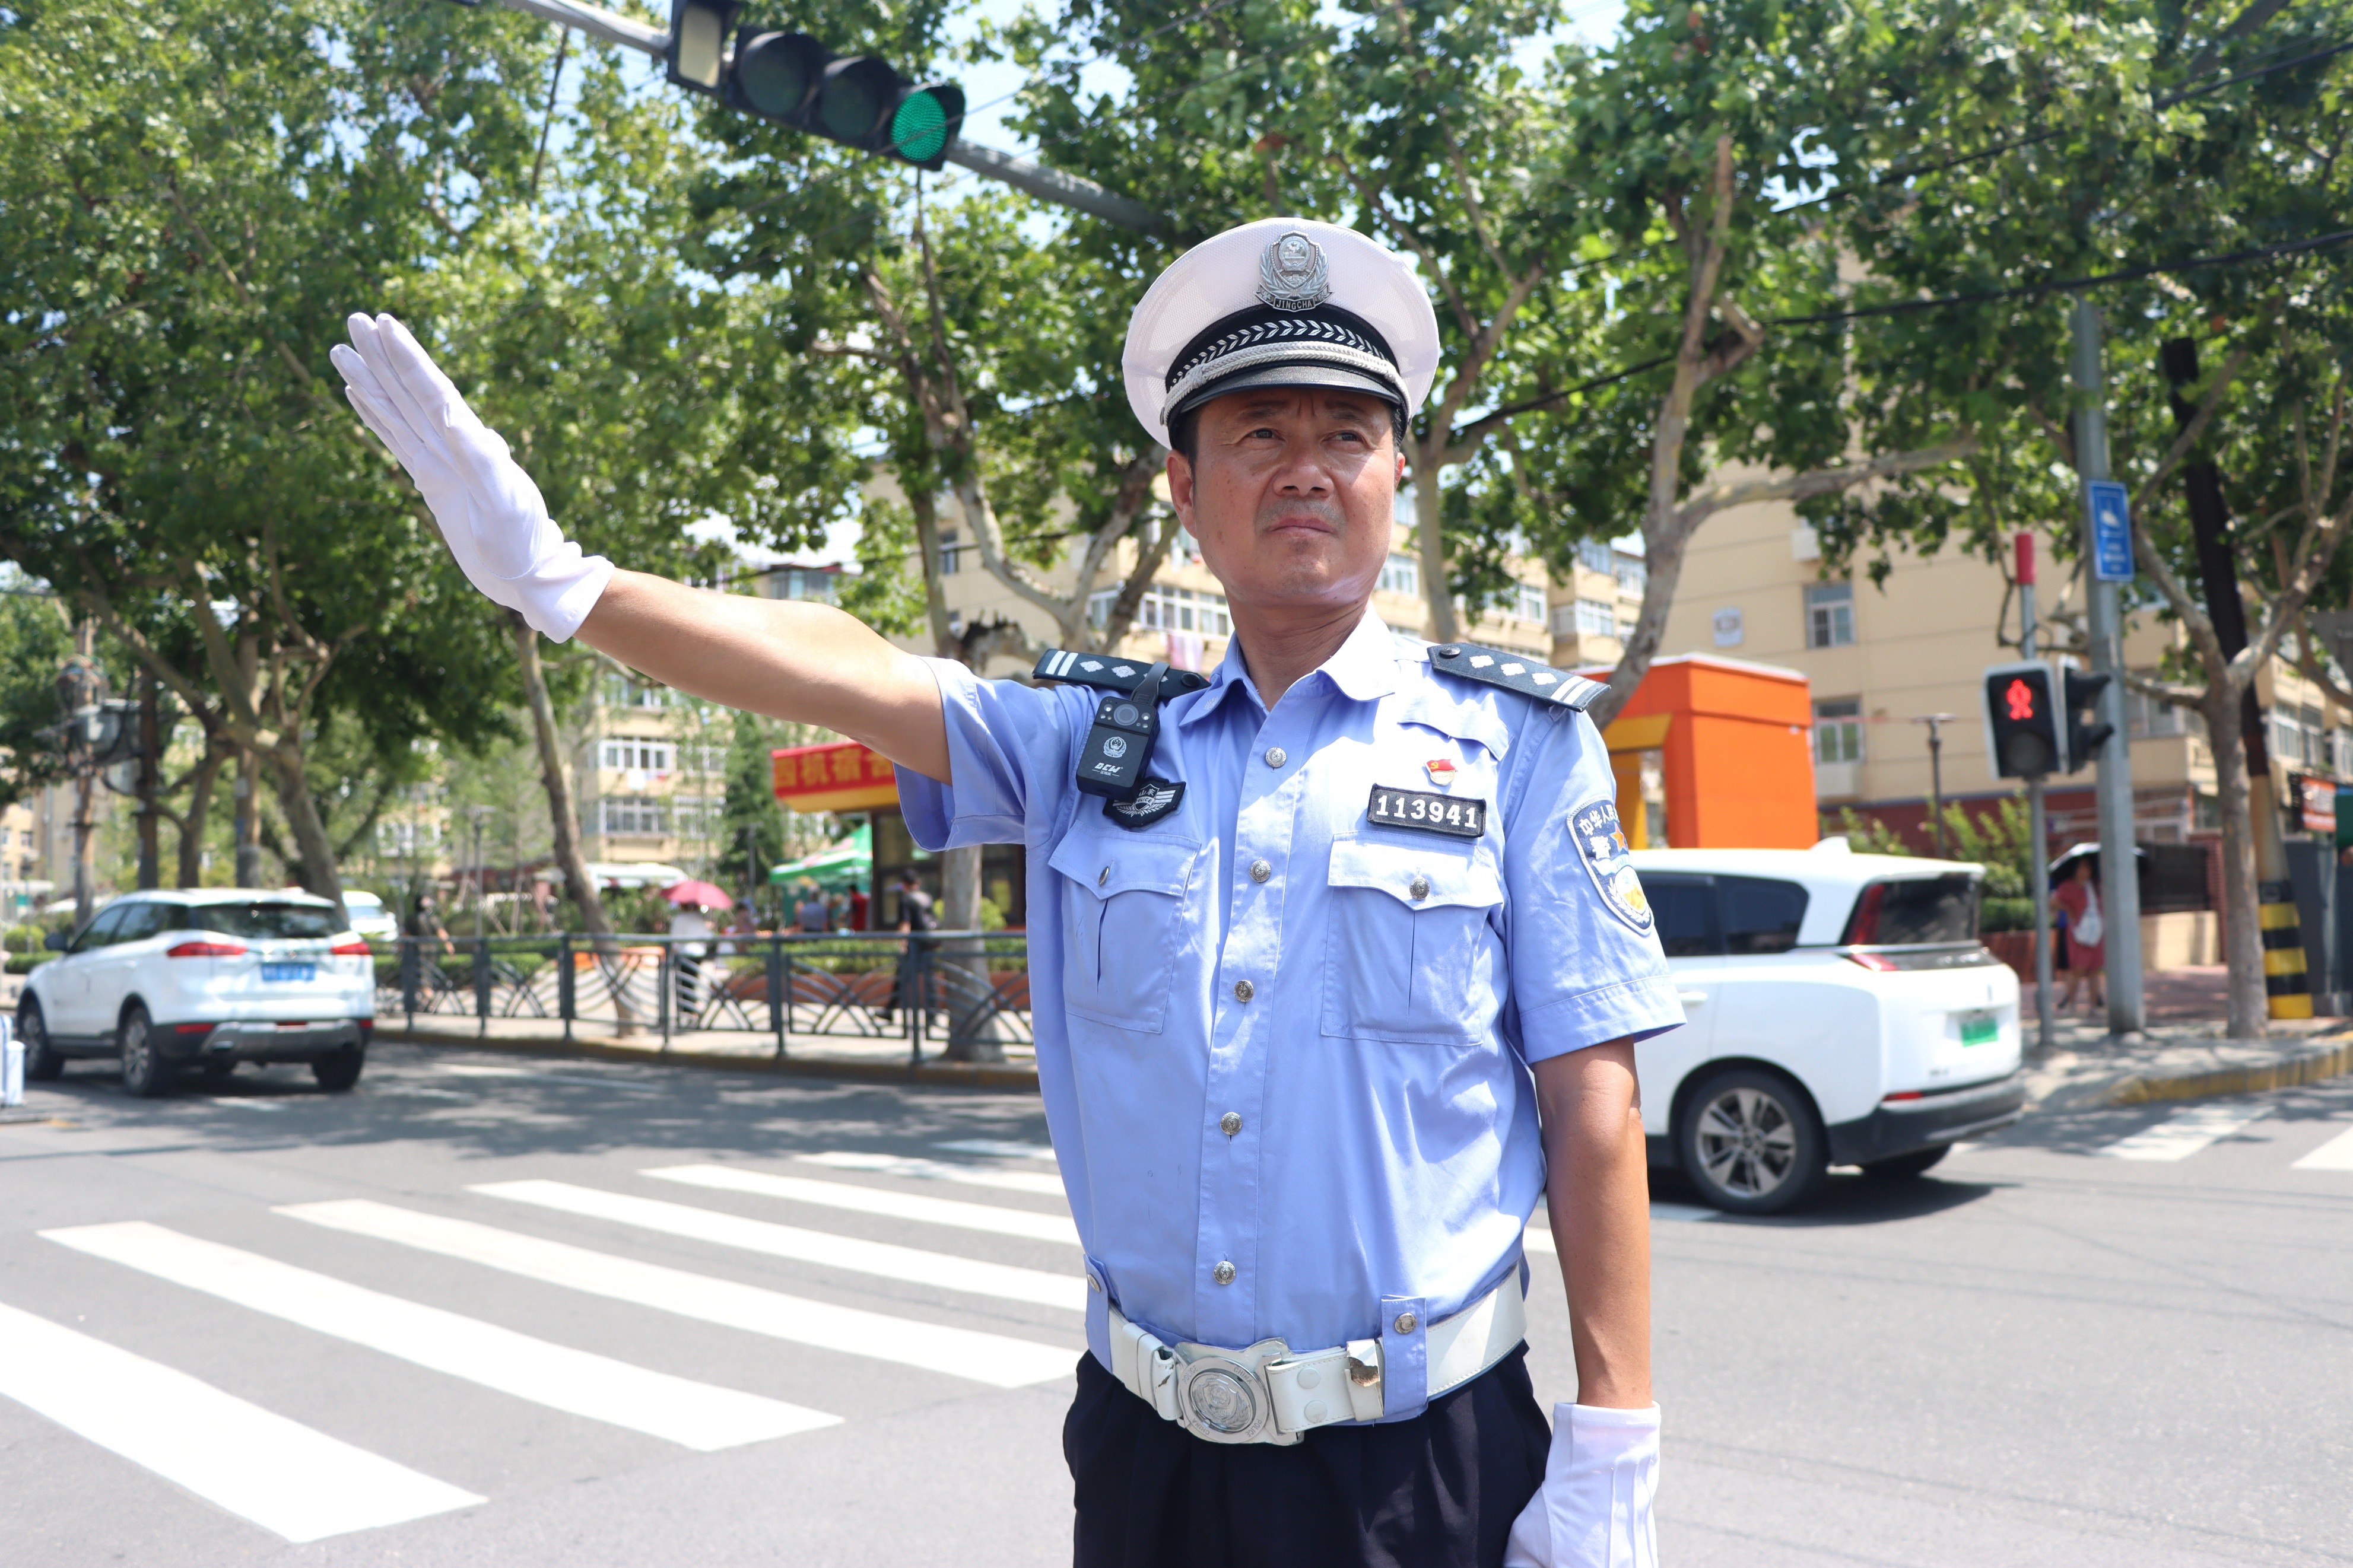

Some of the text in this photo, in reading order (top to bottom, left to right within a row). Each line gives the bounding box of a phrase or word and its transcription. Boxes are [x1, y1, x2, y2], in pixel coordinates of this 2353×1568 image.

[1276, 300, 1313, 310] JINGCHA
[1376, 795, 1477, 828] 113941
[1183, 1365, 1198, 1383] POLICE
[1234, 1366, 1253, 1383] CHINA
[1192, 1418, 1210, 1435] CHINA
[1246, 1418, 1262, 1437] POLICE
